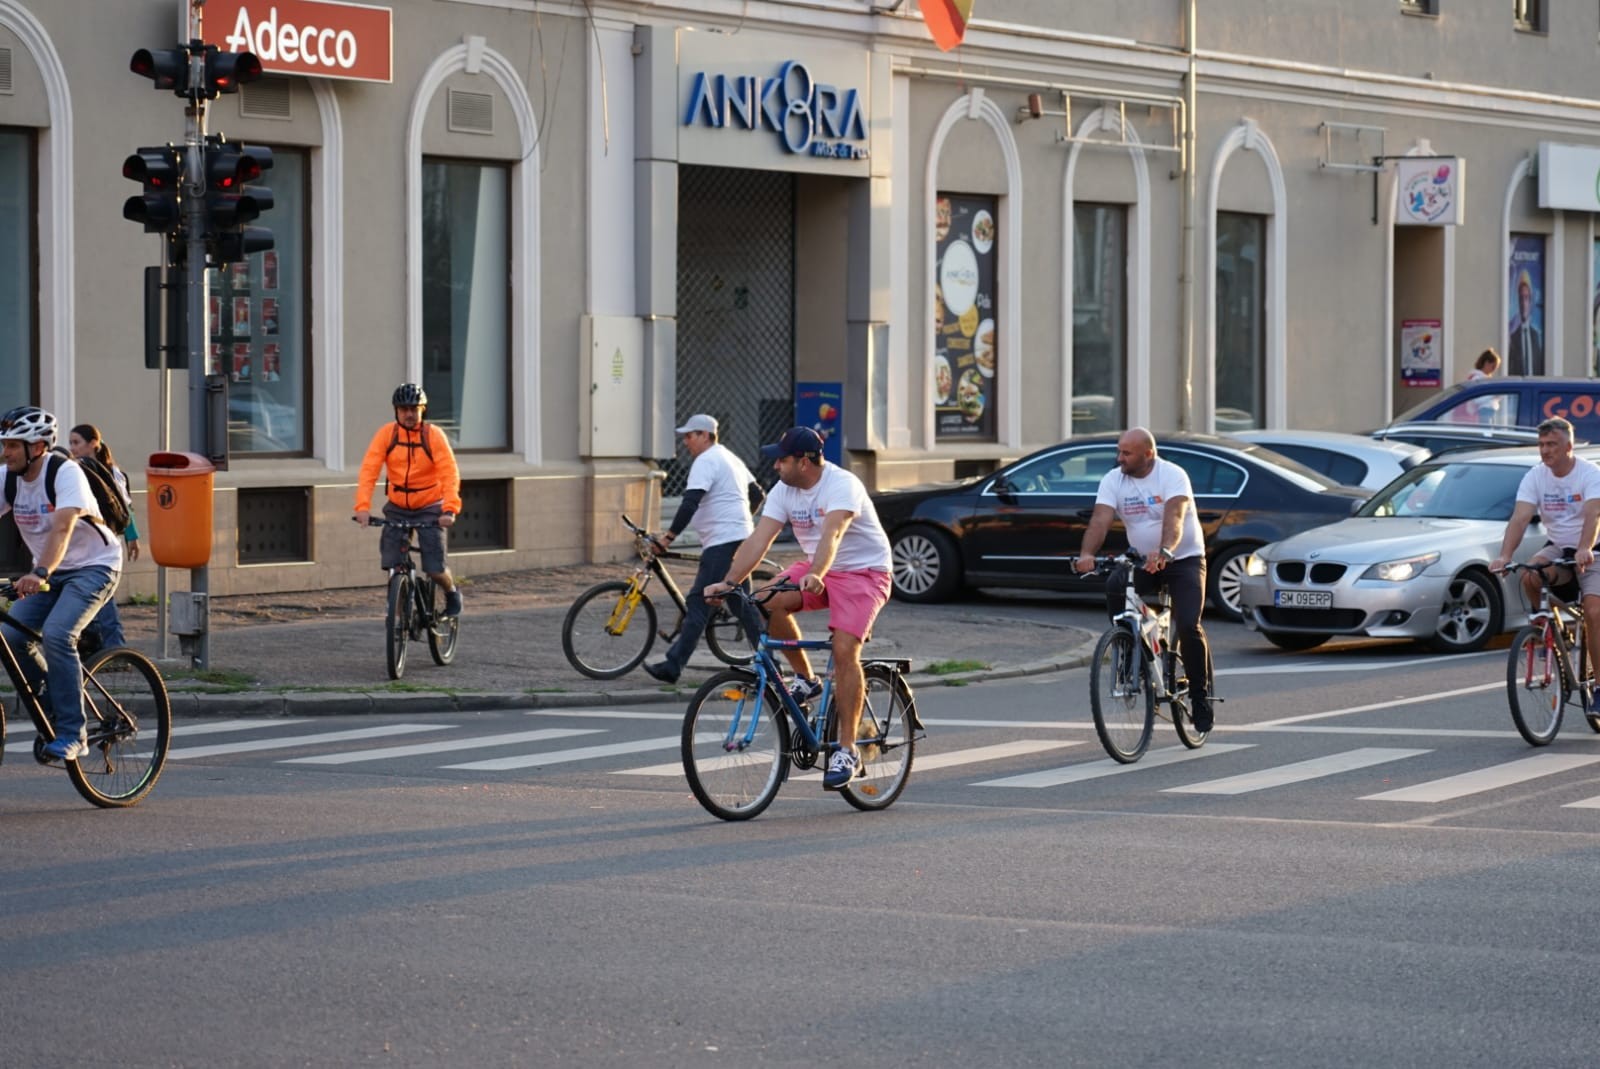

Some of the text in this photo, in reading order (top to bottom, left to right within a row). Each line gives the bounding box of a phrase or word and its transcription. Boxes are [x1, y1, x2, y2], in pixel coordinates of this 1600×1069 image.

[225, 6, 357, 69] Adecco
[1543, 395, 1600, 419] GO
[1280, 592, 1330, 606] SM 09ERP
